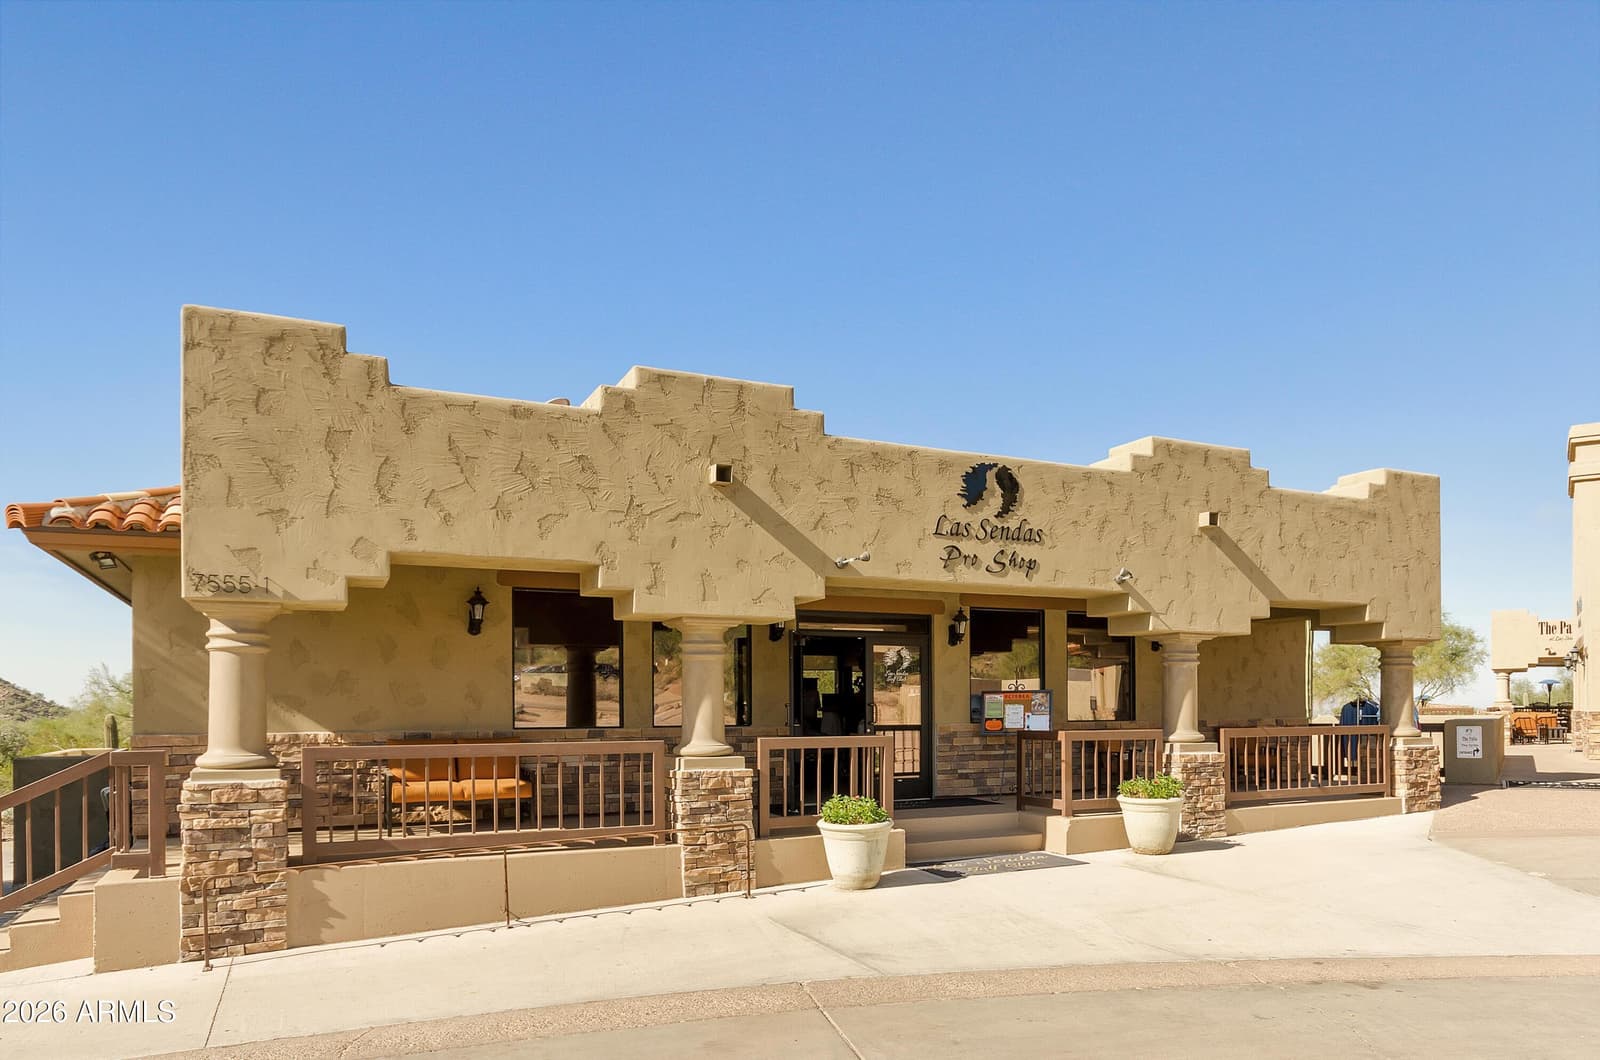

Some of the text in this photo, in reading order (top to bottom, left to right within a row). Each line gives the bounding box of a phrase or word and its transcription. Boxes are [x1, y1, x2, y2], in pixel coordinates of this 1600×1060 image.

[932, 514, 1044, 543] Las Sendas
[939, 545, 1037, 578] Pro Shop
[1537, 621, 1557, 635] The
